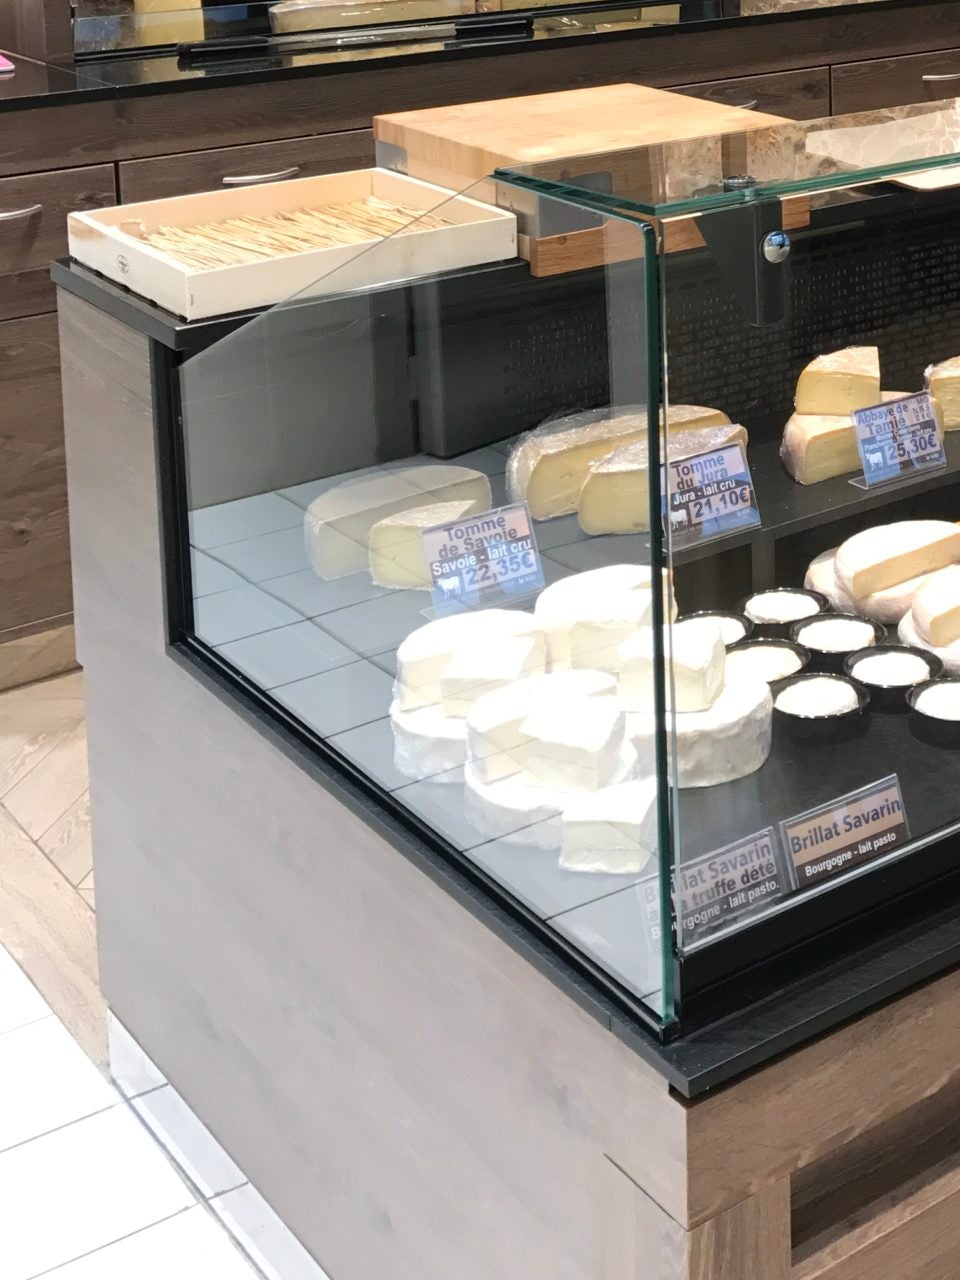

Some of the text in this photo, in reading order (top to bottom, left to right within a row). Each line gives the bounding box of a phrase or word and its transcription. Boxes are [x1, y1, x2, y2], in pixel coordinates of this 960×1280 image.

[857, 403, 909, 426] Abbaye de
[888, 433, 937, 461] 25,30€
[671, 454, 725, 478] Tomme
[676, 467, 729, 490] du Jura
[673, 479, 736, 505] Jura lait cru
[693, 487, 749, 518] 21,10€
[438, 527, 518, 559] de Savoie
[443, 516, 507, 541] Tomme
[432, 539, 532, 576] Savoie lait cru
[465, 550, 534, 586] 22,35€
[790, 798, 902, 854] Brillat Savarin
[708, 841, 772, 880] Savarin
[804, 832, 897, 877] Bourgogne lait pasto
[691, 877, 737, 907] truffe
[728, 879, 780, 909] lait pasto.
